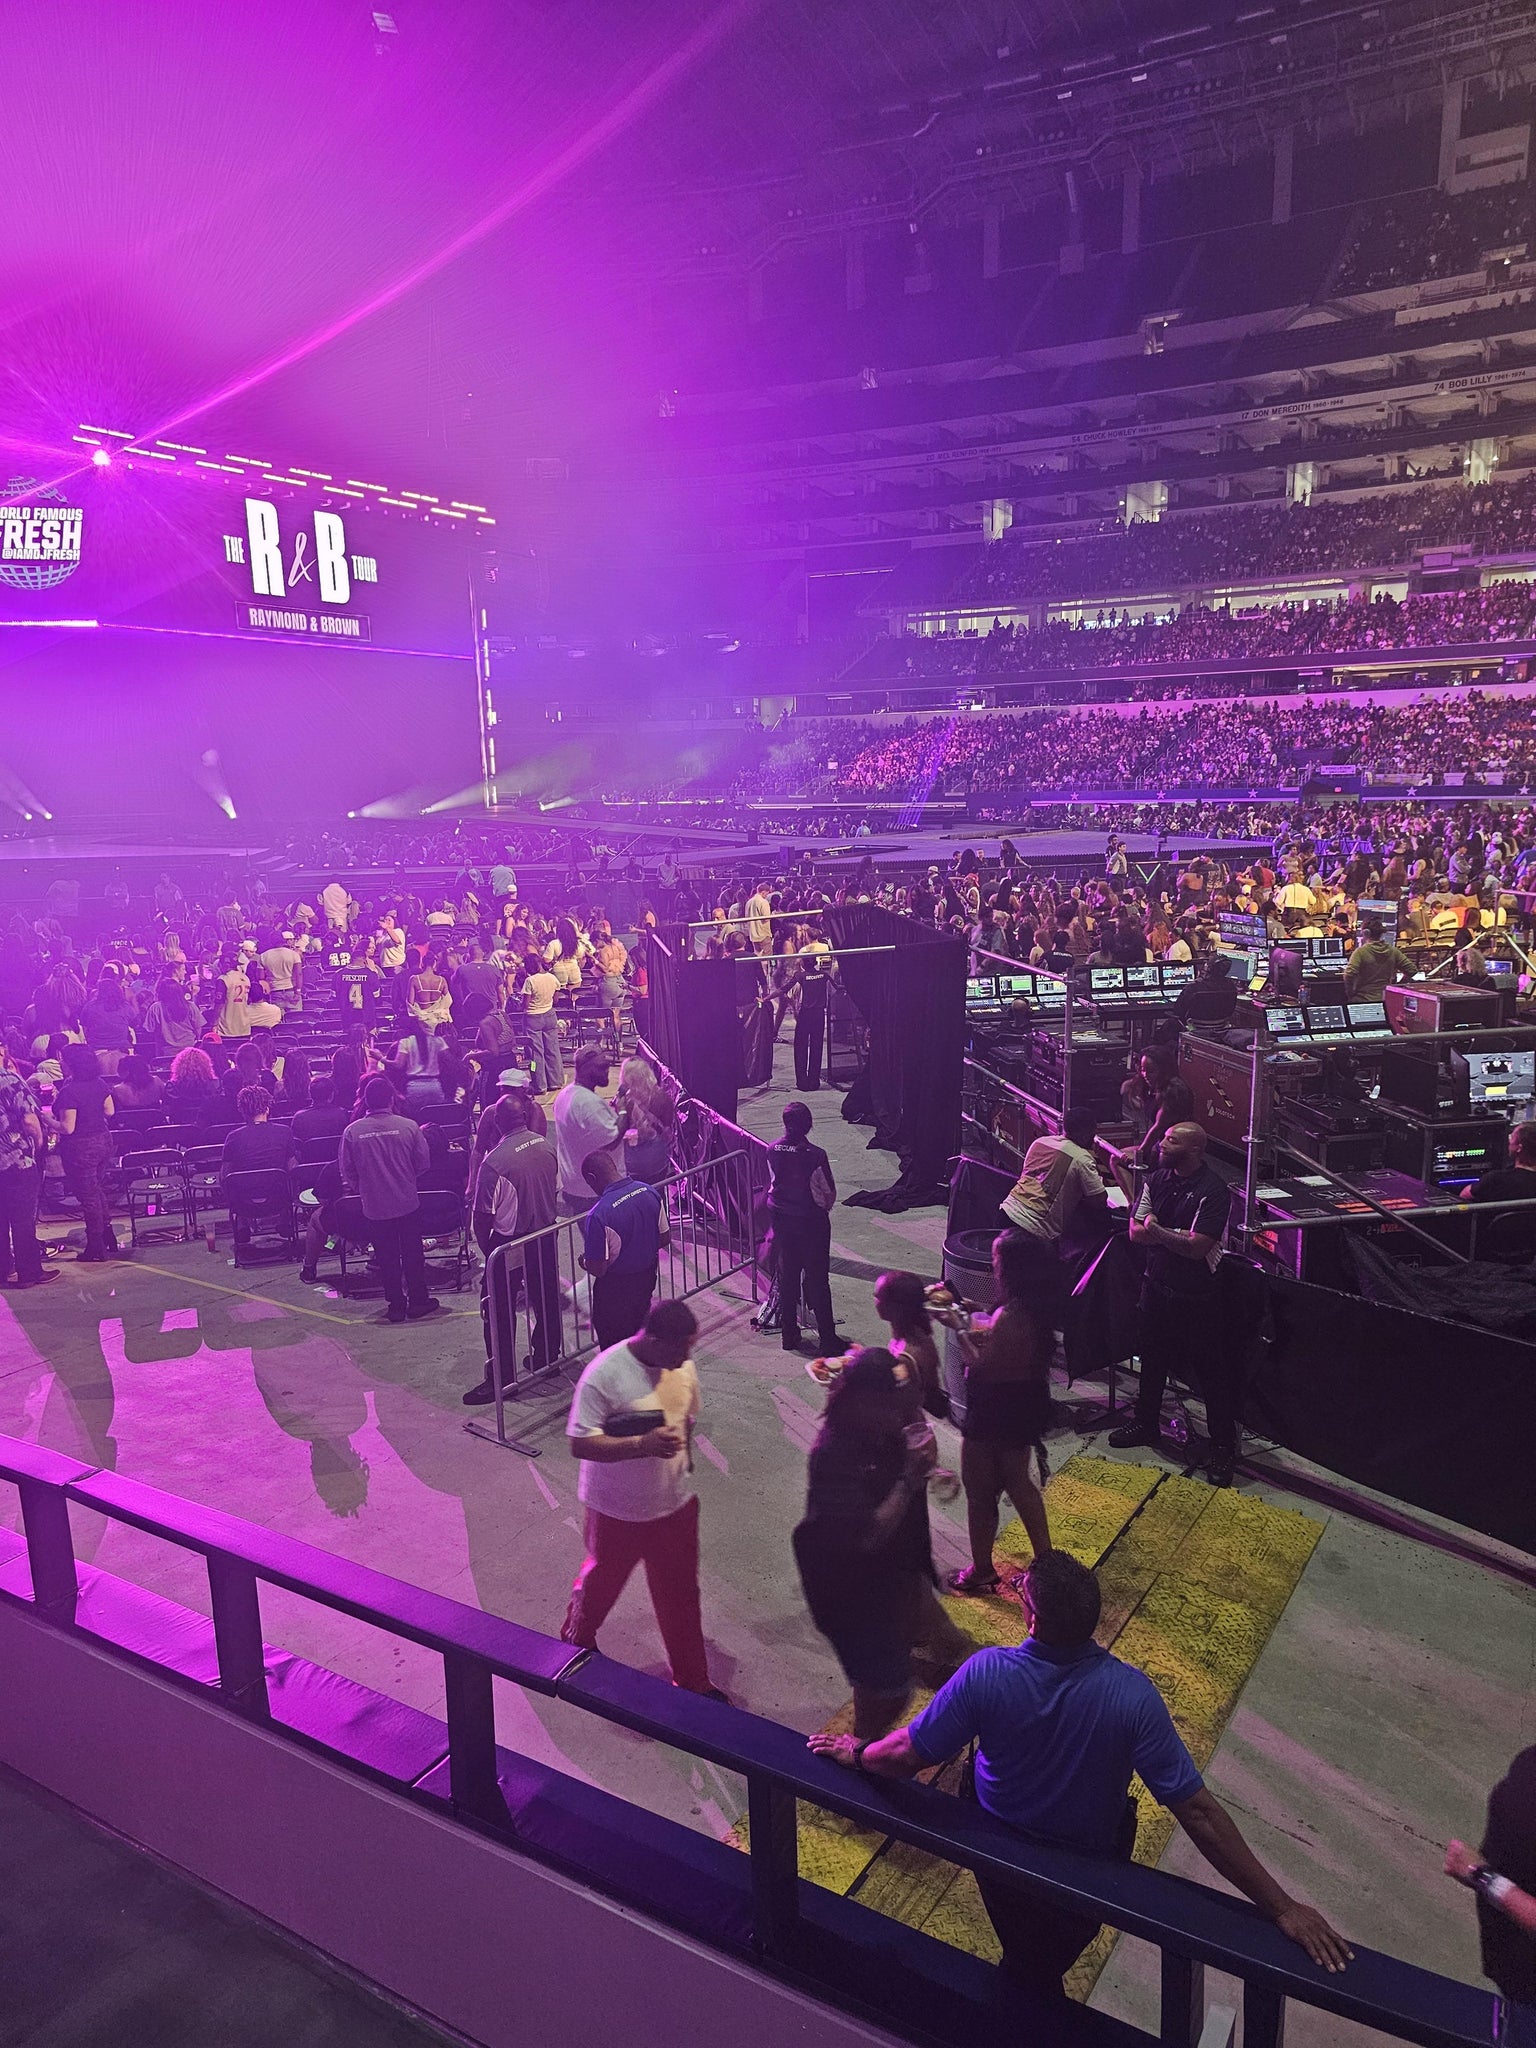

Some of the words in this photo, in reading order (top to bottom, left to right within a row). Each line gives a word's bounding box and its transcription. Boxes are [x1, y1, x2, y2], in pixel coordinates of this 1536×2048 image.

[1434, 383, 1445, 391] 74
[1448, 379, 1468, 389] BOB
[1470, 375, 1493, 386] LILLY
[1252, 410, 1269, 418] DON
[1271, 403, 1311, 415] MEREDITH
[0, 506, 31, 520] ORLD
[33, 507, 83, 521] FAMOUS
[0, 519, 82, 550] RESH
[2, 548, 81, 561] @IAMDJFRESH
[223, 535, 246, 564] THE
[351, 554, 378, 582] TOUR
[249, 608, 307, 631] RAYMOND
[310, 616, 318, 632] &
[320, 616, 360, 636] BROWN
[342, 974, 368, 982] PRESCOTT
[349, 983, 364, 1010] 4
[514, 1141, 530, 1153] GUEST
